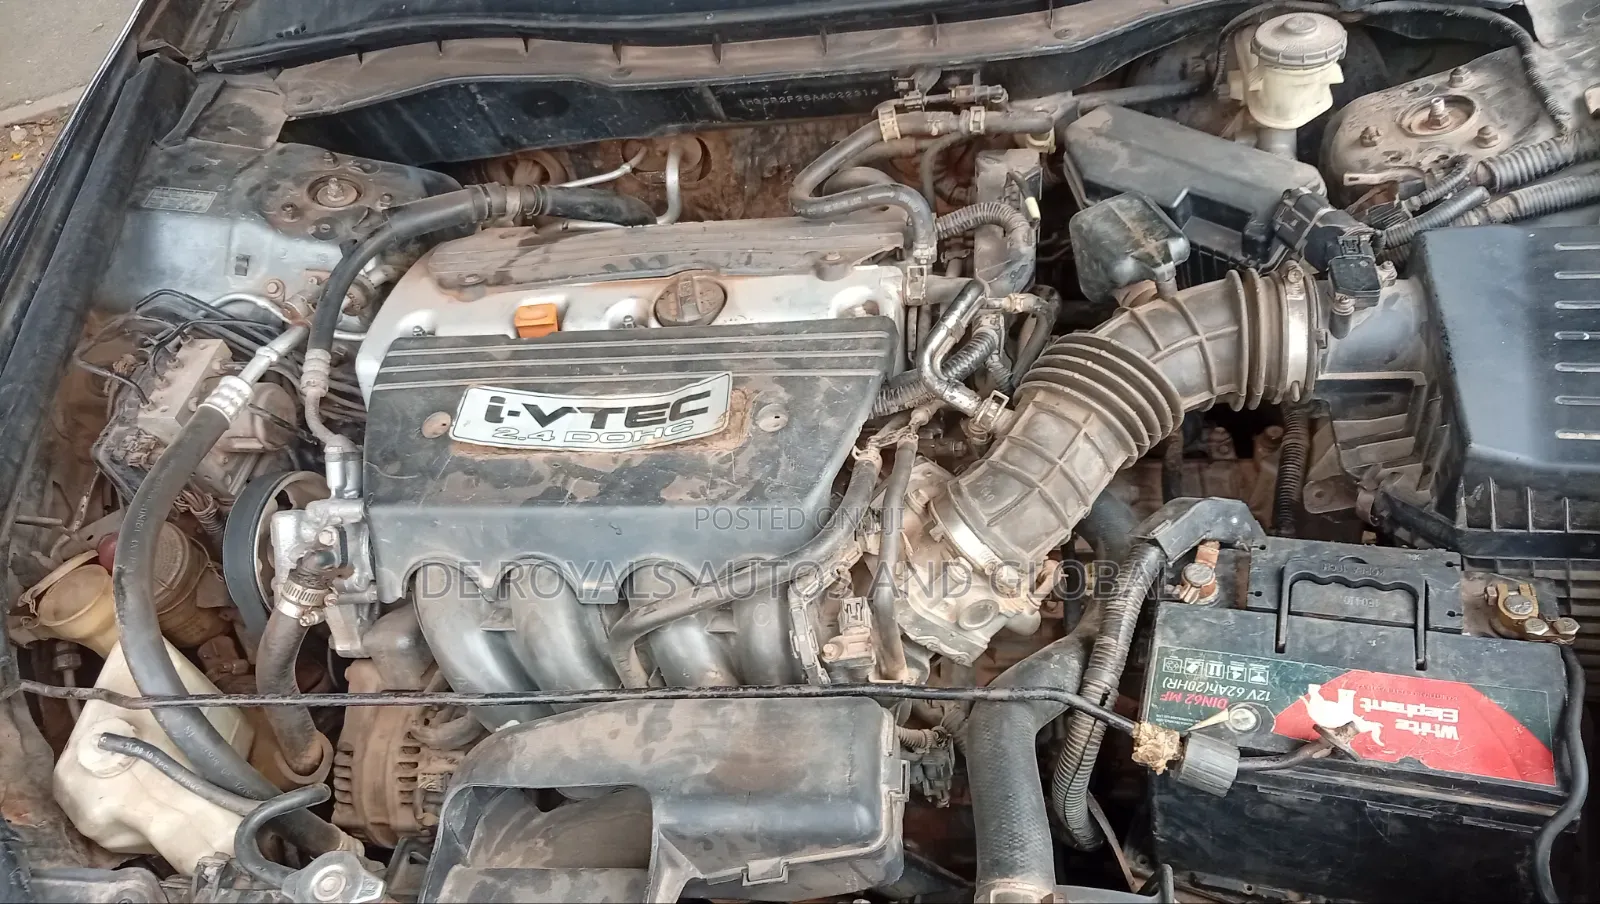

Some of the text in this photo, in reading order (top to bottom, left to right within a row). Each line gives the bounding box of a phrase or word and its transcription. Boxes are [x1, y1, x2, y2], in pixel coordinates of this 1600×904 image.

[483, 389, 712, 430] i-VTEC
[492, 420, 694, 444] 2.4 DOHC
[1160, 690, 1229, 710] DIN62 MF
[1162, 676, 1271, 702] 12V 62Ah(20HR)
[1360, 697, 1459, 723] Elephant
[1395, 718, 1459, 740] White
